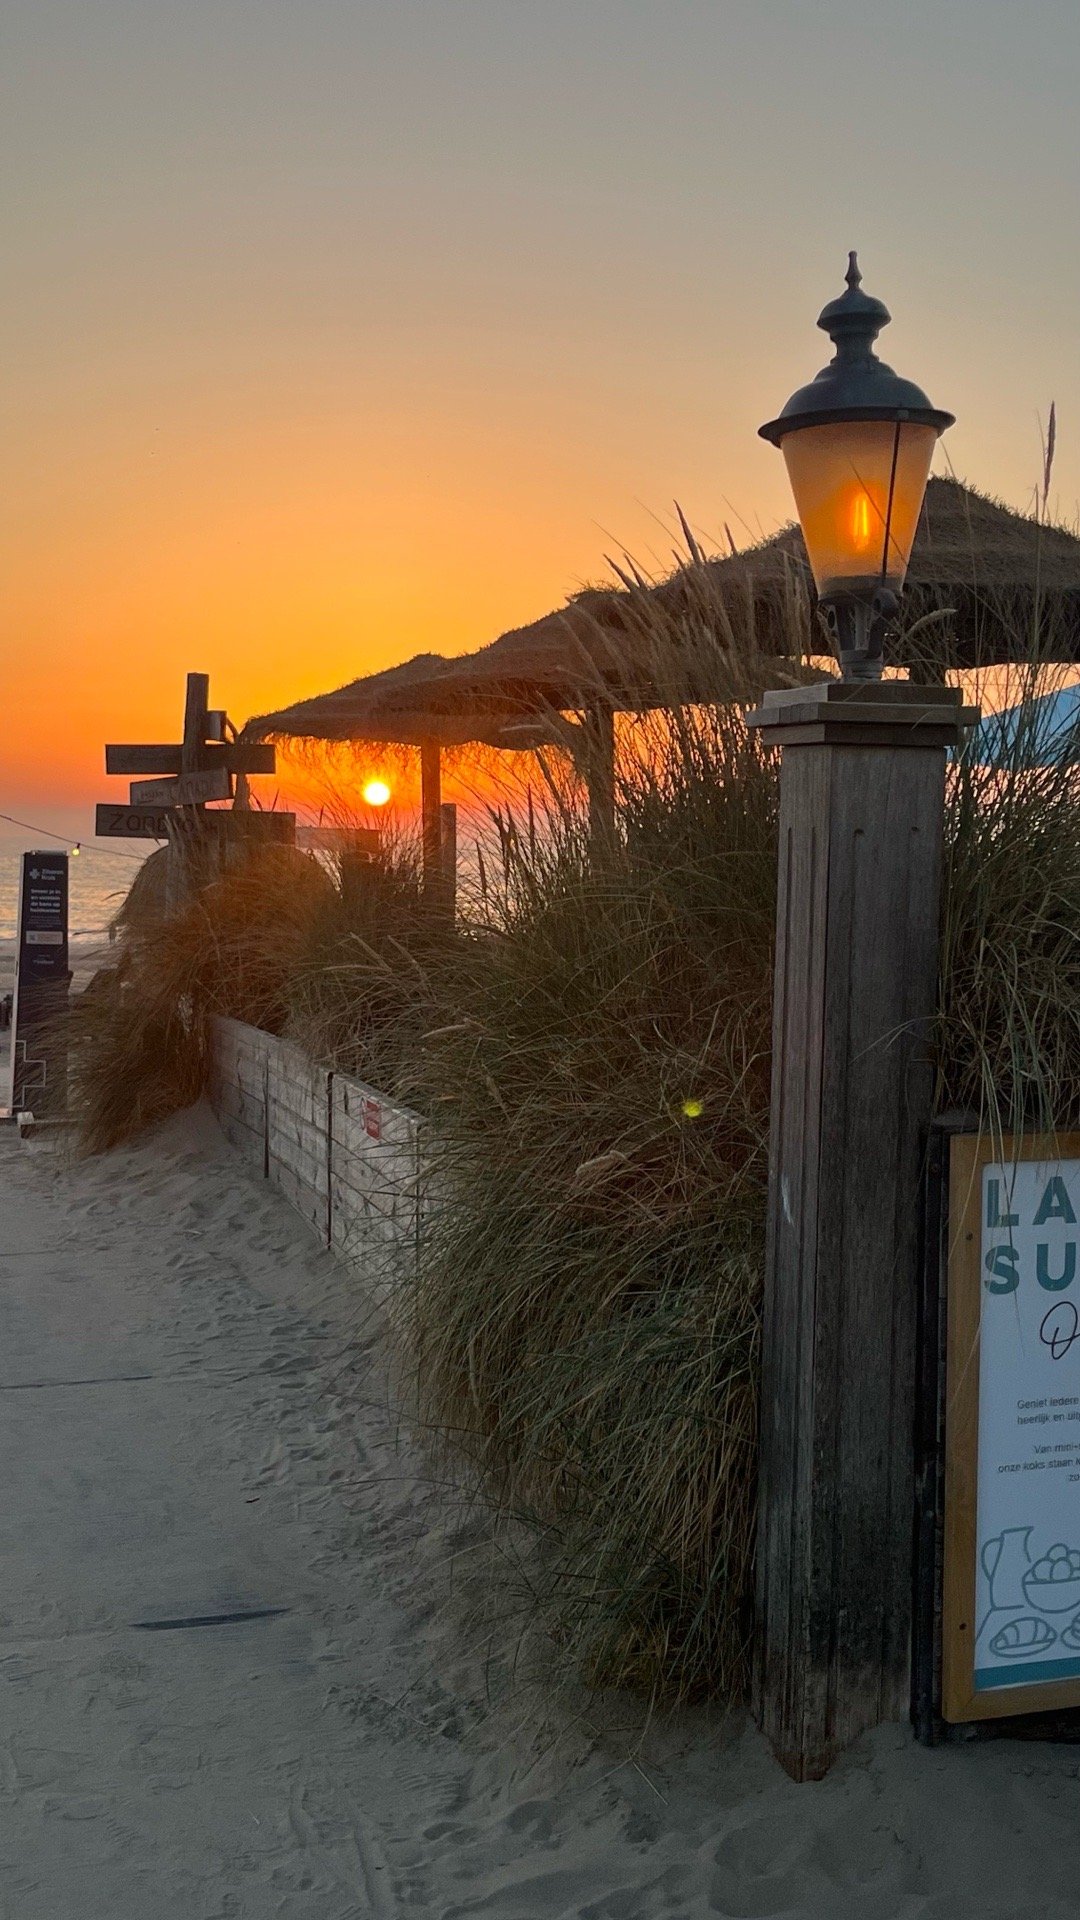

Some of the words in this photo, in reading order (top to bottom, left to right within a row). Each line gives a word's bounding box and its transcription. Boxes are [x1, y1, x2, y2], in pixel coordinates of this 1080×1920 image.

[987, 1176, 1077, 1228] LA
[984, 1241, 1077, 1295] SU
[1017, 1398, 1047, 1410] Geniet
[1050, 1396, 1079, 1407] iedere
[1017, 1413, 1050, 1425] heerlijk
[1053, 1414, 1065, 1422] en
[1033, 1444, 1052, 1454] Van
[998, 1463, 1021, 1473] onze
[1023, 1460, 1046, 1471] koks
[1048, 1458, 1073, 1469] staan
